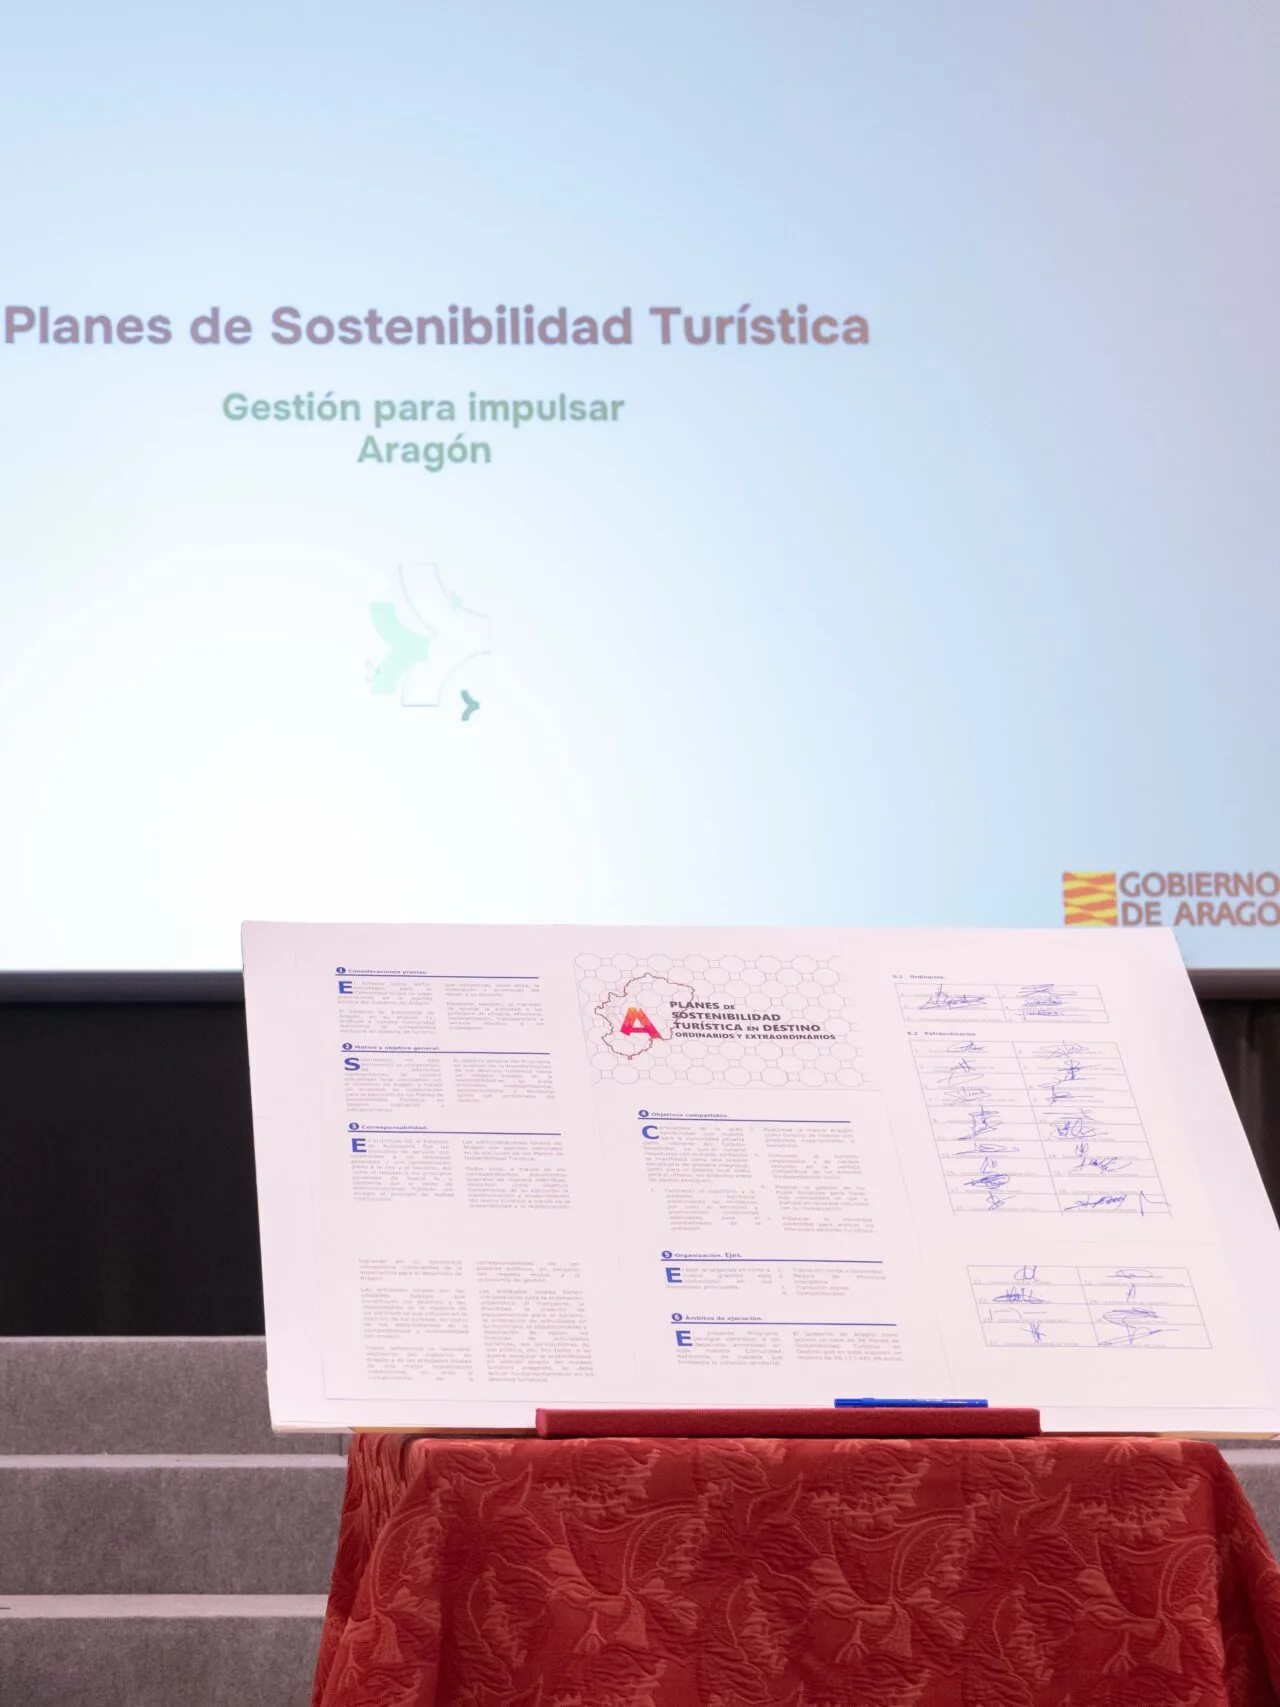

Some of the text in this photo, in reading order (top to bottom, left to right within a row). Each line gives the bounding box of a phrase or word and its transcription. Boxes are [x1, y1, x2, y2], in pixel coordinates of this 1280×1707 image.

[5, 303, 870, 345] Planes de Sostenibilidad Turística
[223, 391, 625, 428] Gestión para impulsar
[356, 434, 492, 473] Aragón
[1119, 871, 1280, 898] GOBIERNO
[1121, 901, 1162, 926] DE
[670, 1001, 720, 1010] PLANES
[672, 1012, 781, 1021] SOSTENIBILIDAD
[674, 1021, 743, 1031] TURÍSTICA
[763, 1024, 821, 1032] DESTINO
